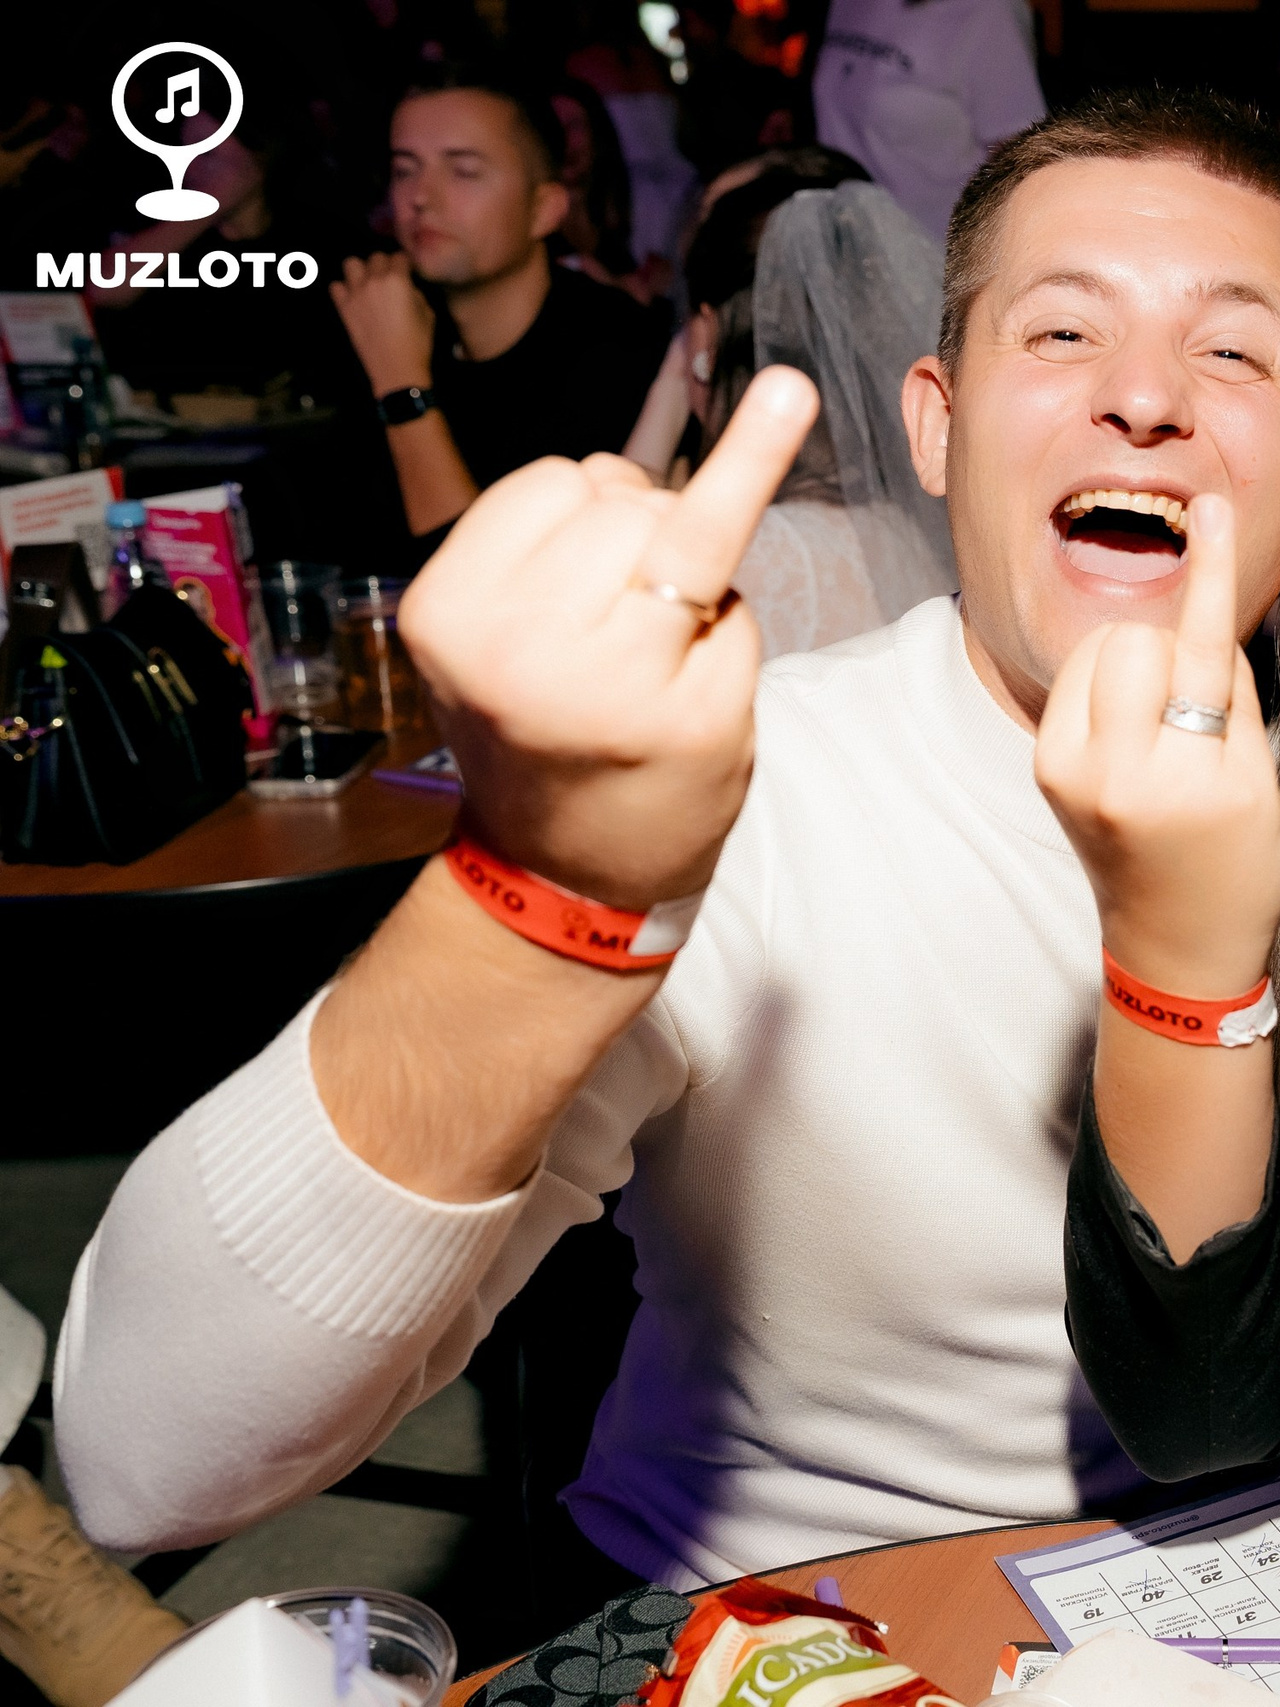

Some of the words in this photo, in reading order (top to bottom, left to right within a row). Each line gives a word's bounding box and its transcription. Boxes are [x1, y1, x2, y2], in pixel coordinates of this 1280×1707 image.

[1131, 1514, 1200, 1541] @muzloto.spb
[1182, 1557, 1220, 1573] Non-Stop
[1257, 1552, 1280, 1567] 34
[1191, 1564, 1220, 1576] REFLEX
[1200, 1570, 1224, 1585] 29
[1063, 1587, 1106, 1602] Пропадаю
[1121, 1587, 1143, 1597] ГРИМ
[1142, 1590, 1165, 1603] 40
[1060, 1592, 1109, 1608] УСПЕНСКАЯ
[1214, 1596, 1258, 1612] Хали-Гали
[1083, 1607, 1104, 1620] 19
[1213, 1599, 1268, 1620] ЛЕПРИКОНСЫ
[1156, 1612, 1188, 1624] любовь
[1166, 1614, 1198, 1628] Выпьем
[1235, 1611, 1257, 1625] 31
[1154, 1620, 1196, 1638] НИКОЛАЕВ
